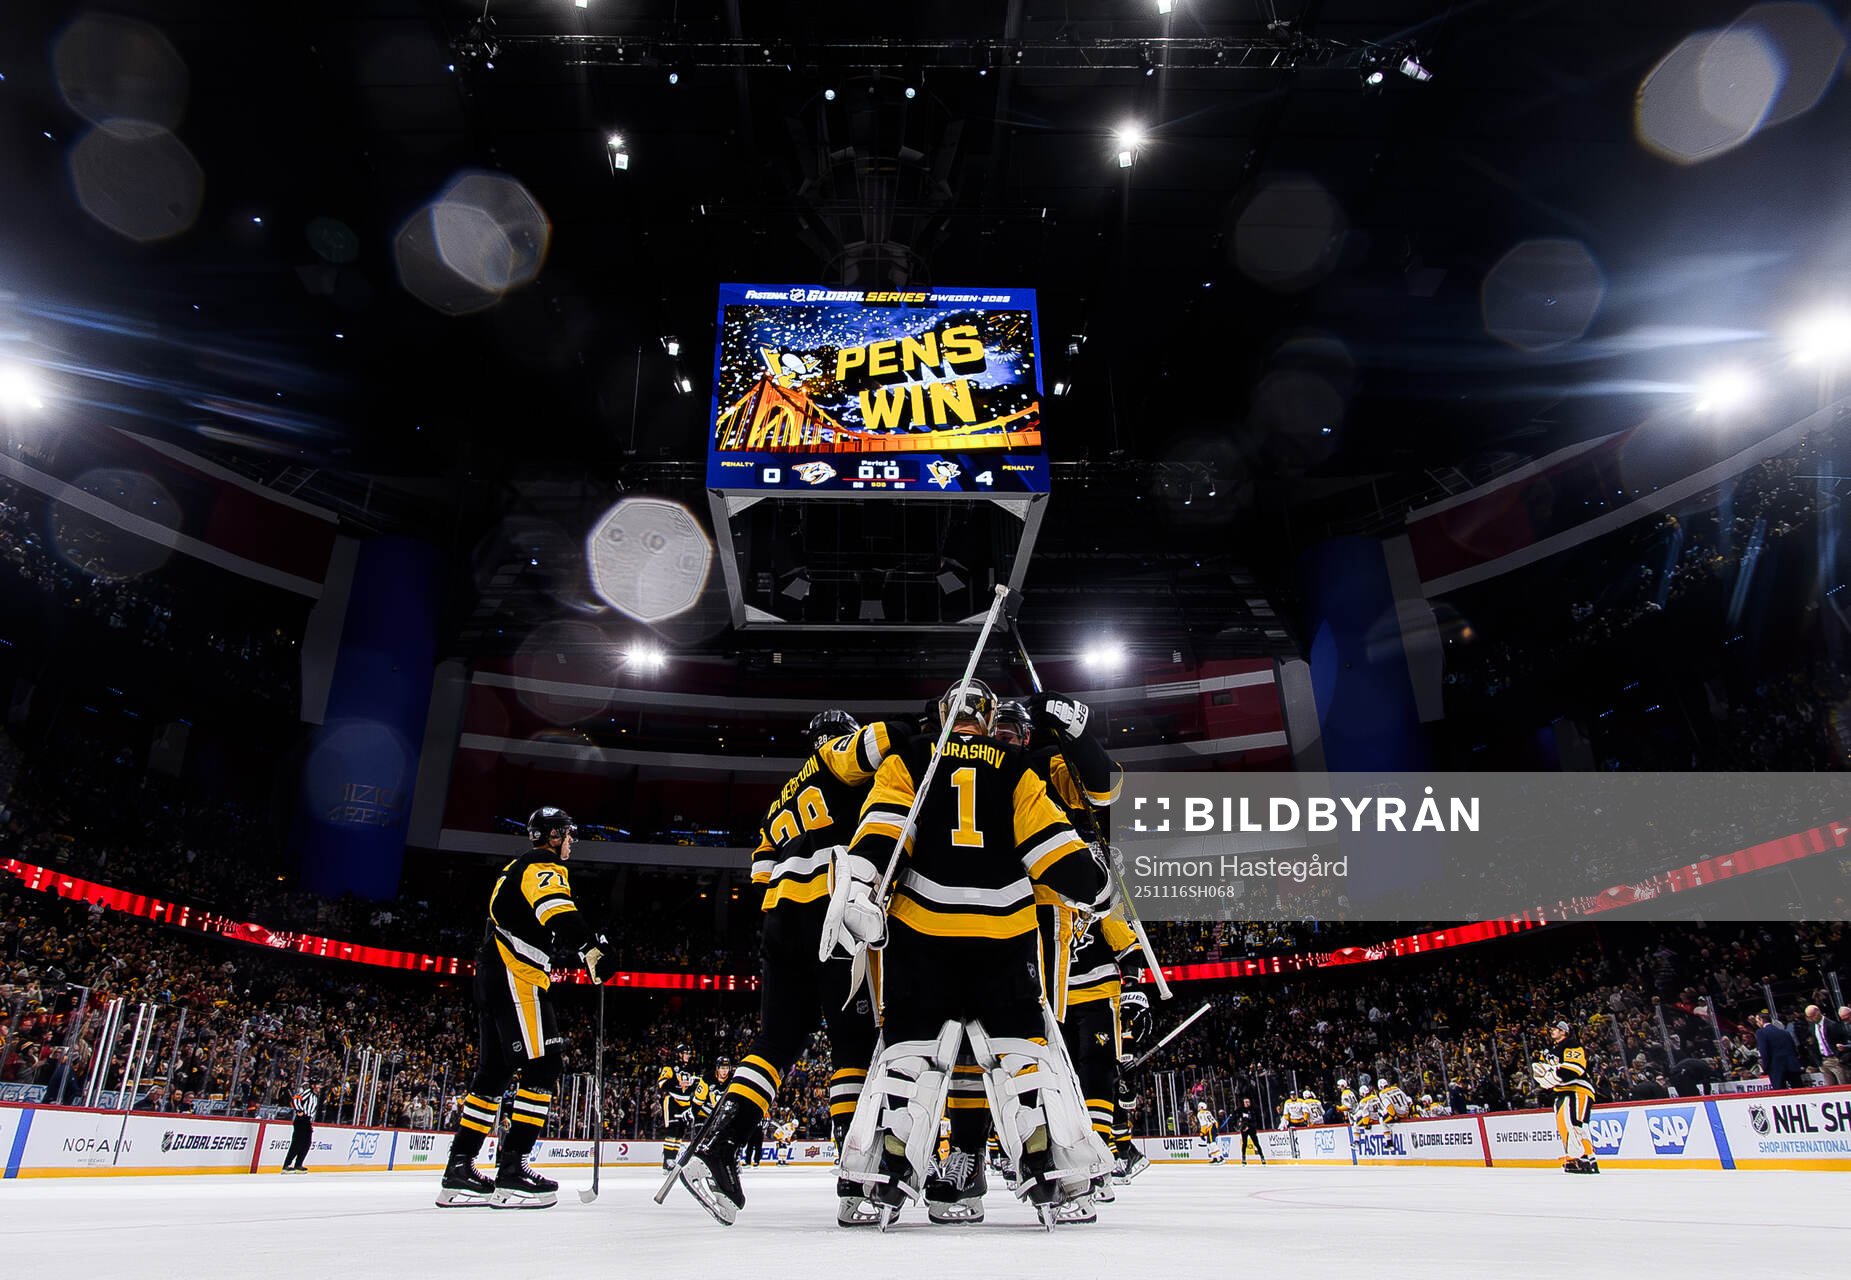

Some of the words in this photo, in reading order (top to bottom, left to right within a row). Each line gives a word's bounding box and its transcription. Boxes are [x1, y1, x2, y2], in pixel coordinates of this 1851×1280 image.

[806, 290, 864, 301] GLOBAL
[866, 292, 926, 302] SERIES
[836, 325, 985, 381] PENS
[859, 380, 977, 429] WIN
[763, 468, 780, 483] 0
[975, 470, 993, 485] 4
[951, 767, 984, 848] 1
[536, 871, 569, 889] 71
[1771, 1104, 1818, 1133] NHL
[1419, 1133, 1444, 1147] GLOBAL
[1445, 1132, 1473, 1145] SERIES
[1589, 1119, 1623, 1148] SAP
[1649, 1116, 1689, 1147] SAP
[172, 1134, 211, 1150] GLOBAL
[211, 1136, 248, 1150] SERIES
[409, 1134, 435, 1151] UNIBET
[1163, 1138, 1193, 1150] UNIBET
